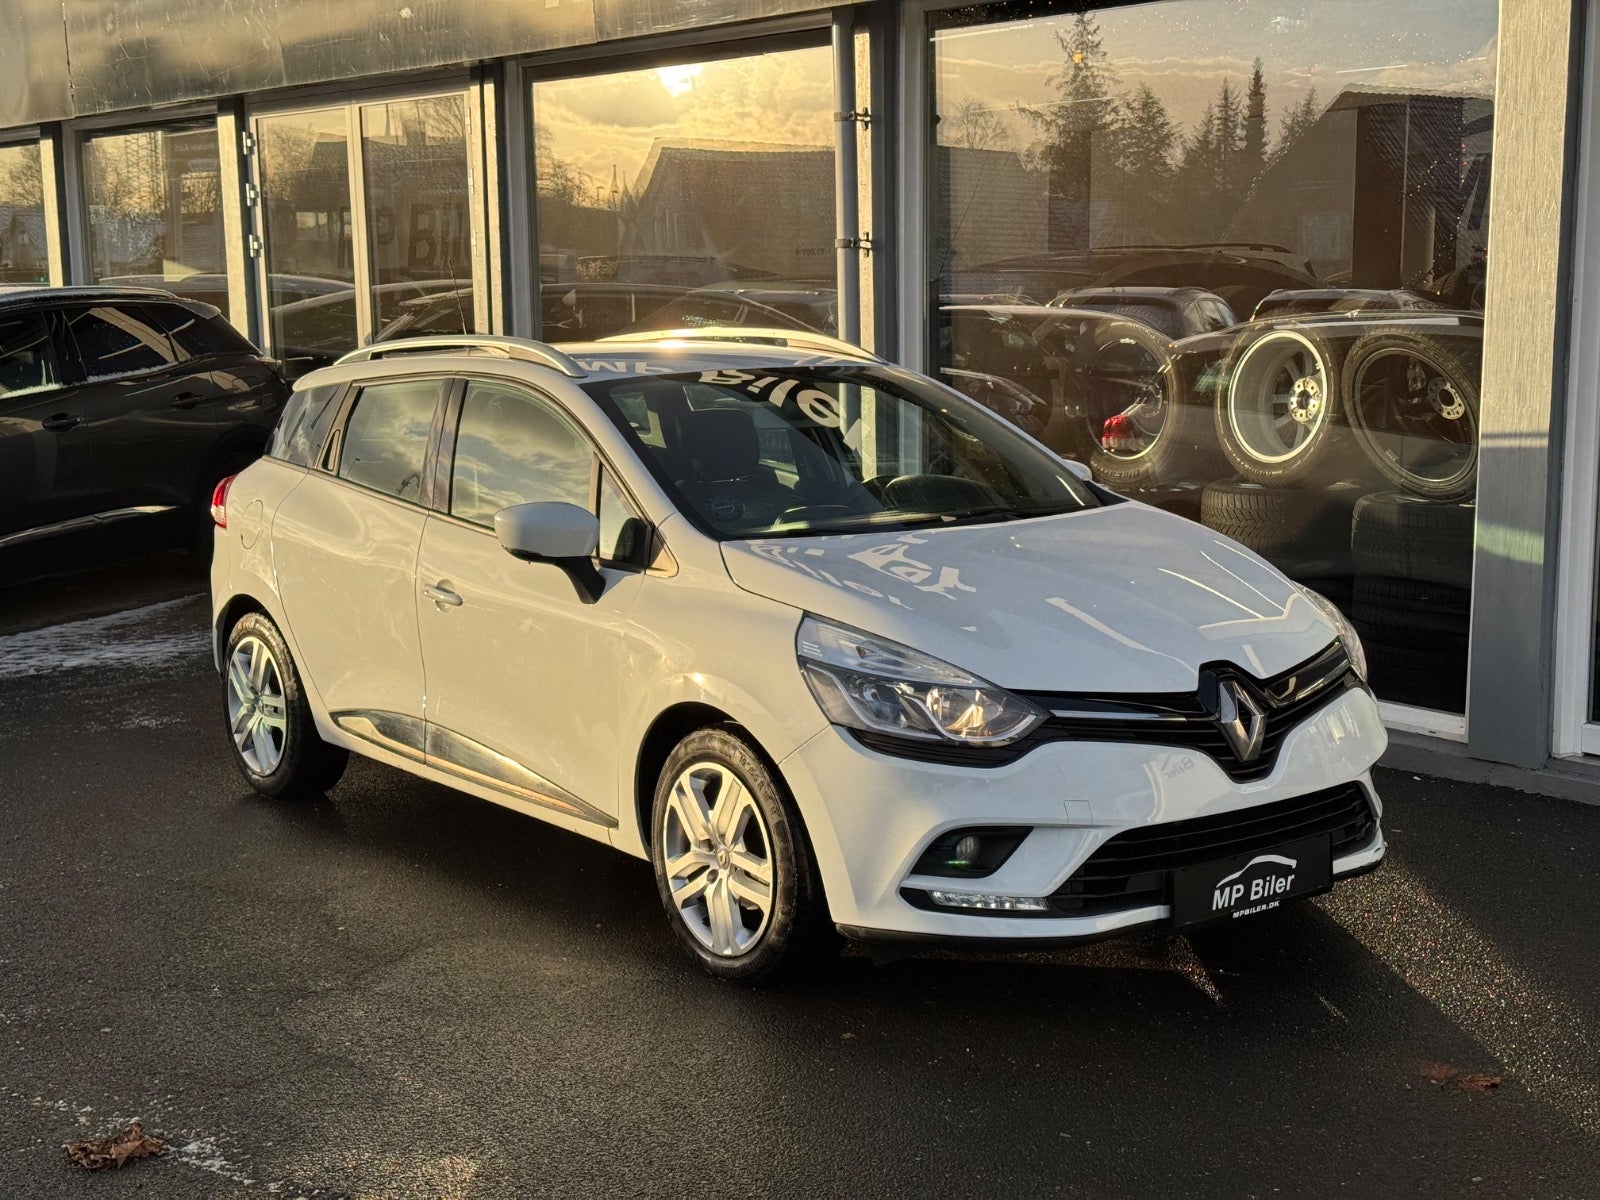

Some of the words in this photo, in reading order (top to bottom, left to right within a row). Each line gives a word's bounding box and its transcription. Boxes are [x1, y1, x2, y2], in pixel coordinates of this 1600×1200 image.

[1212, 883, 1245, 911] MP
[1249, 874, 1295, 901] Biler
[1232, 900, 1280, 919] MPBILER.DK
